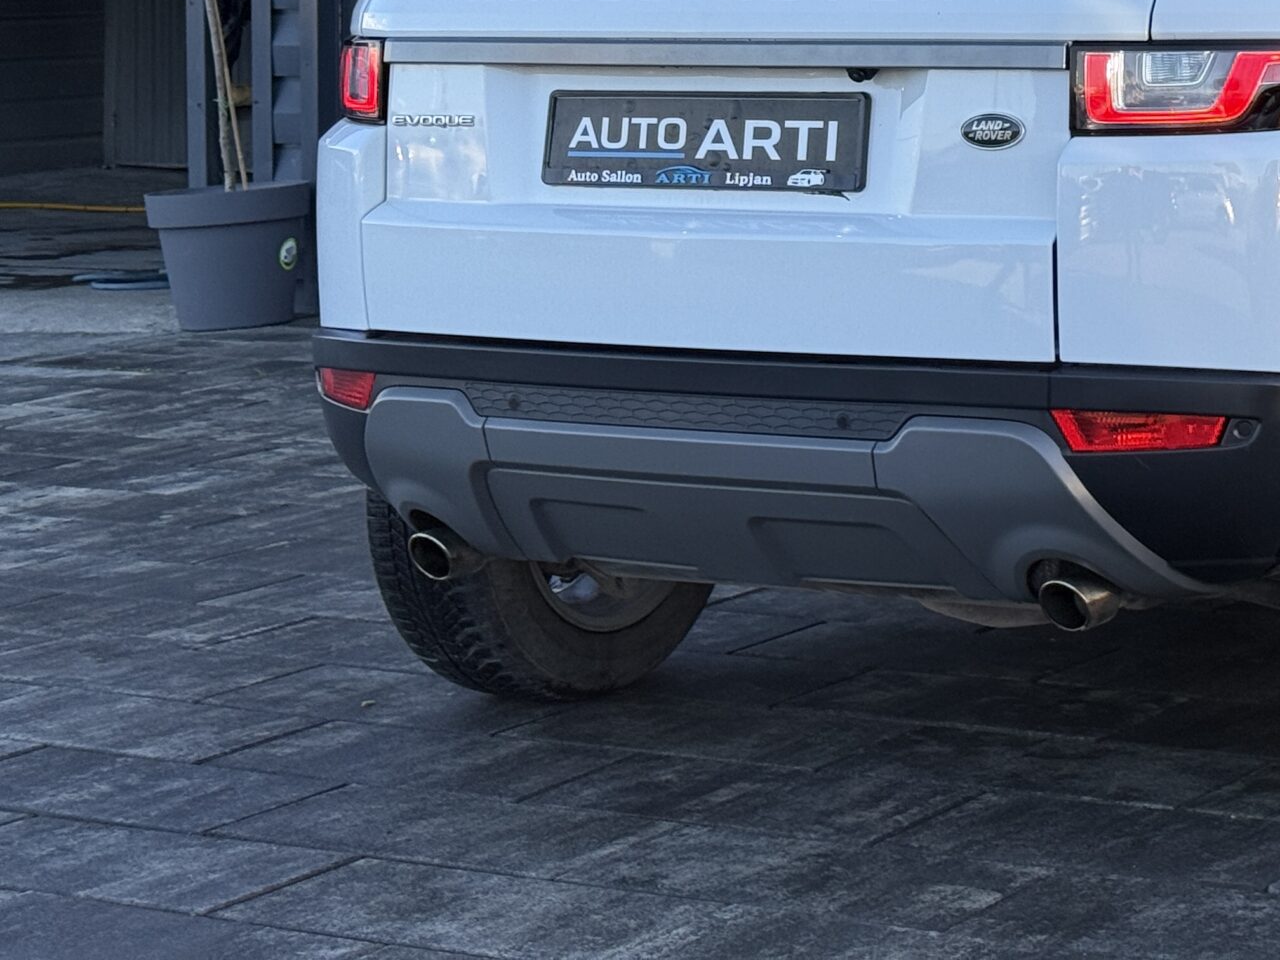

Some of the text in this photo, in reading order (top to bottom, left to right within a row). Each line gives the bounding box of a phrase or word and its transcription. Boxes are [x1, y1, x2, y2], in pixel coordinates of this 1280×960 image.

[392, 114, 475, 128] EVOQUE
[972, 120, 1003, 131] LAND
[568, 116, 839, 162] AUTO ARTI
[974, 130, 1013, 141] ROVER
[567, 168, 772, 187] Auto Sallon ARTI Lipjan
